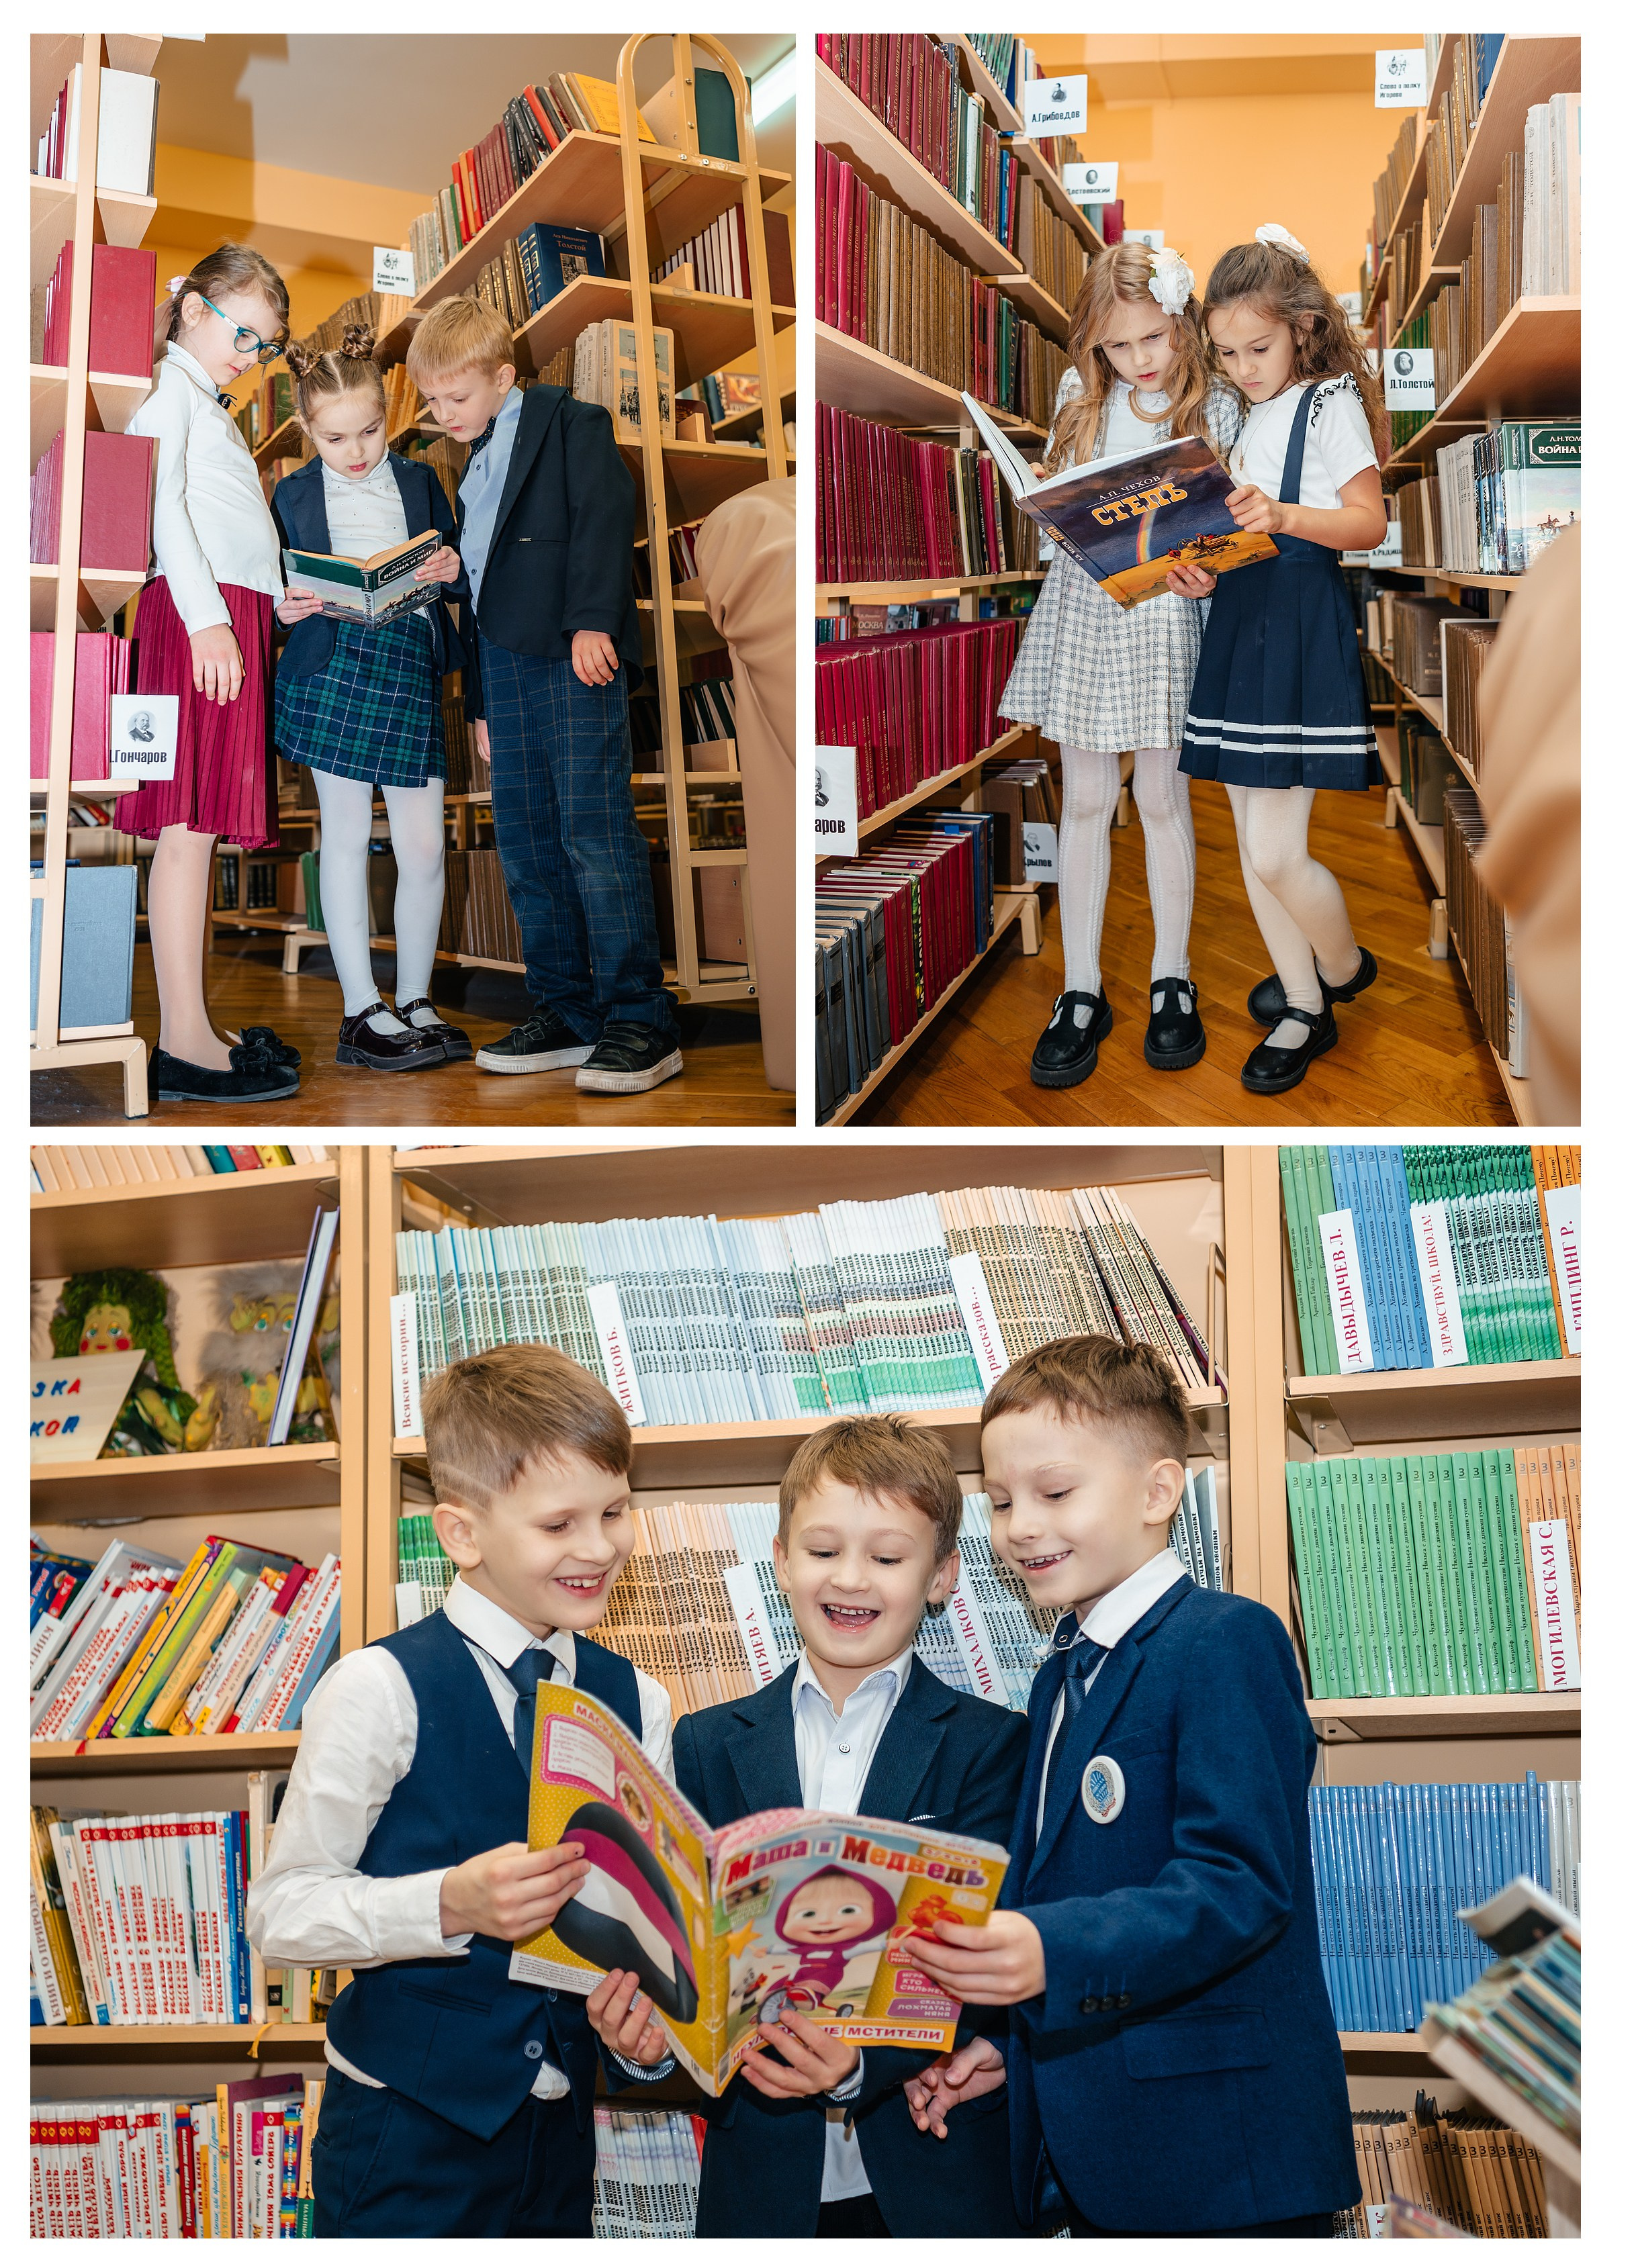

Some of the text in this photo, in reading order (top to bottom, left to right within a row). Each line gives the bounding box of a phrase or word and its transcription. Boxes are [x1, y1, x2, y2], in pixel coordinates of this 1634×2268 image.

[1032, 111, 1080, 123] А.Грибоедов
[556, 240, 586, 251] Толстой
[1390, 379, 1435, 389] Л.Толстой
[1538, 444, 1574, 454] ВОЙНА
[1099, 475, 1161, 501] А.П. ЧЕХОВ
[1091, 482, 1188, 526] СТЕПЬ
[1045, 526, 1064, 542] СТЕПЬ
[1061, 541, 1076, 555] ЧЕХОВ
[384, 563, 410, 579] ВОЙНА
[416, 549, 433, 561] МИР
[109, 750, 167, 764] .Гончаров
[1493, 1204, 1501, 1234] ШКОЛА!
[1560, 1221, 1574, 1236] Р.
[1126, 1223, 1143, 1252] ДУРОВЫХ
[1358, 1223, 1366, 1248] подъезда
[1361, 1249, 1369, 1273] третьего
[1140, 1255, 1170, 1312] ДРЕССИРОВЩИКОВ
[1330, 1229, 1363, 1364] ДАВЫДЫЧЕВ Л.
[1421, 1215, 1453, 1356] ЗДРАВСТВУЙ, ШКОЛА!
[696, 1285, 705, 1315] ПОМОЩЬ
[705, 1323, 714, 1348] Житков
[1169, 1315, 1187, 1349] РАССКАЗОВ
[606, 1326, 634, 1413] ЖИТКОВ Б.
[402, 1377, 412, 1428] Всякие
[1505, 1463, 1511, 1471] 3
[957, 1536, 970, 1565] ЗИМОВКЕ
[754, 1562, 766, 1593] ОВСЯНКИ
[967, 1568, 974, 1577] НА
[971, 1580, 983, 1603] СЛУЧАЙ
[1539, 1523, 1567, 1687] МОГИЛЕВСКАЯ С.
[764, 1595, 773, 1619] МЕШОК
[983, 1611, 996, 1645] Михалков
[745, 1607, 774, 1687] ИТЯЕВ А.
[953, 1597, 995, 1695] МИХАЛКОВ
[725, 1839, 811, 1887] Маша
[840, 1834, 988, 1887] Медведь
[848, 2027, 940, 2040] МСТИТЕЛИ
[1410, 2126, 1416, 2135] 3
